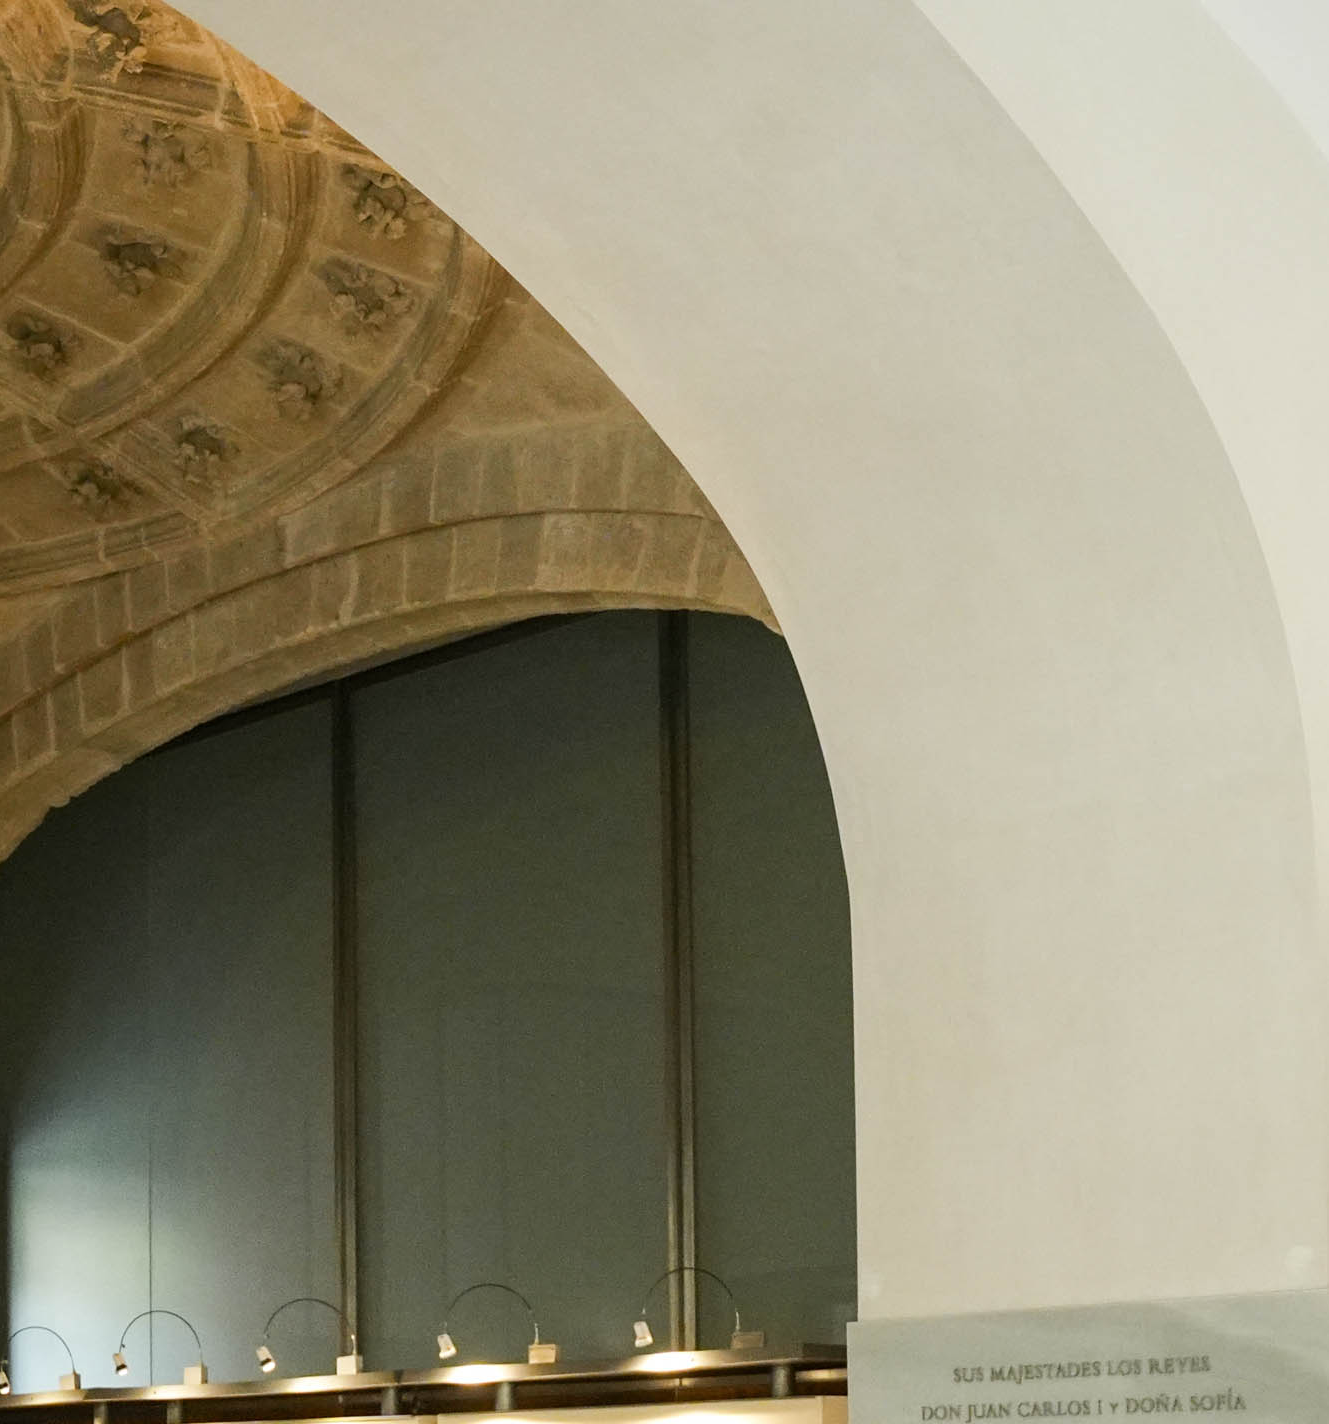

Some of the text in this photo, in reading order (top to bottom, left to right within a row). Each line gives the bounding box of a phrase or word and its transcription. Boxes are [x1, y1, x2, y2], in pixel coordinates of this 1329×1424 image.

[953, 1355, 1211, 1384] SUS MAJESTADES LOS REYES
[921, 1404, 961, 1421] DON
[965, 1402, 1011, 1423] JUAN
[1017, 1400, 1091, 1417] CARLOS
[1125, 1393, 1183, 1413] DOÑA
[1190, 1387, 1247, 1411] SOFÍA
